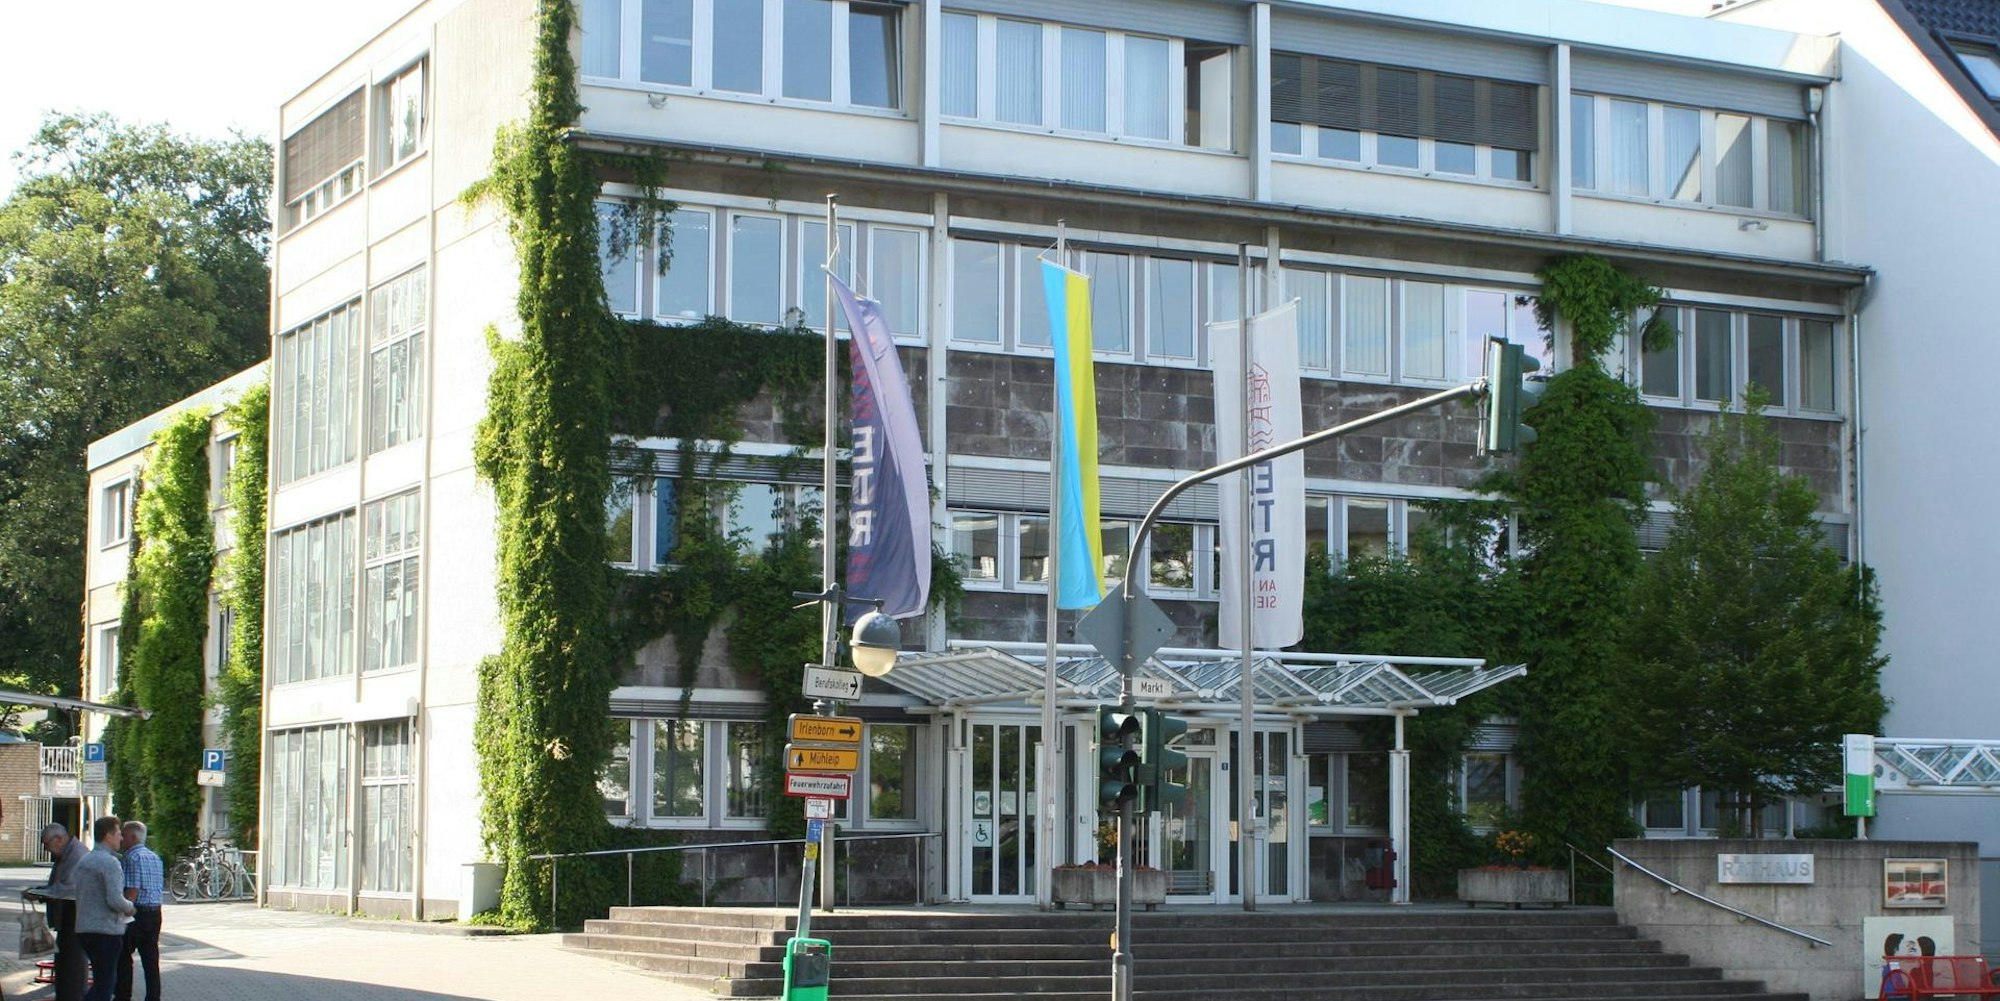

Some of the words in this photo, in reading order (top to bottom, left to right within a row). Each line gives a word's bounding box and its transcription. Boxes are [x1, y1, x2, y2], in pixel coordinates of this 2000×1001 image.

[815, 676, 849, 693] Berufskolleg
[1140, 681, 1163, 693] Markt
[800, 722, 835, 736] Irlenborn
[88, 745, 99, 760] P
[207, 751, 220, 769] P
[809, 752, 840, 767] Mühleip
[789, 778, 847, 791] Feuerwehrzufahrt
[1723, 861, 1810, 877] RATHAUS
